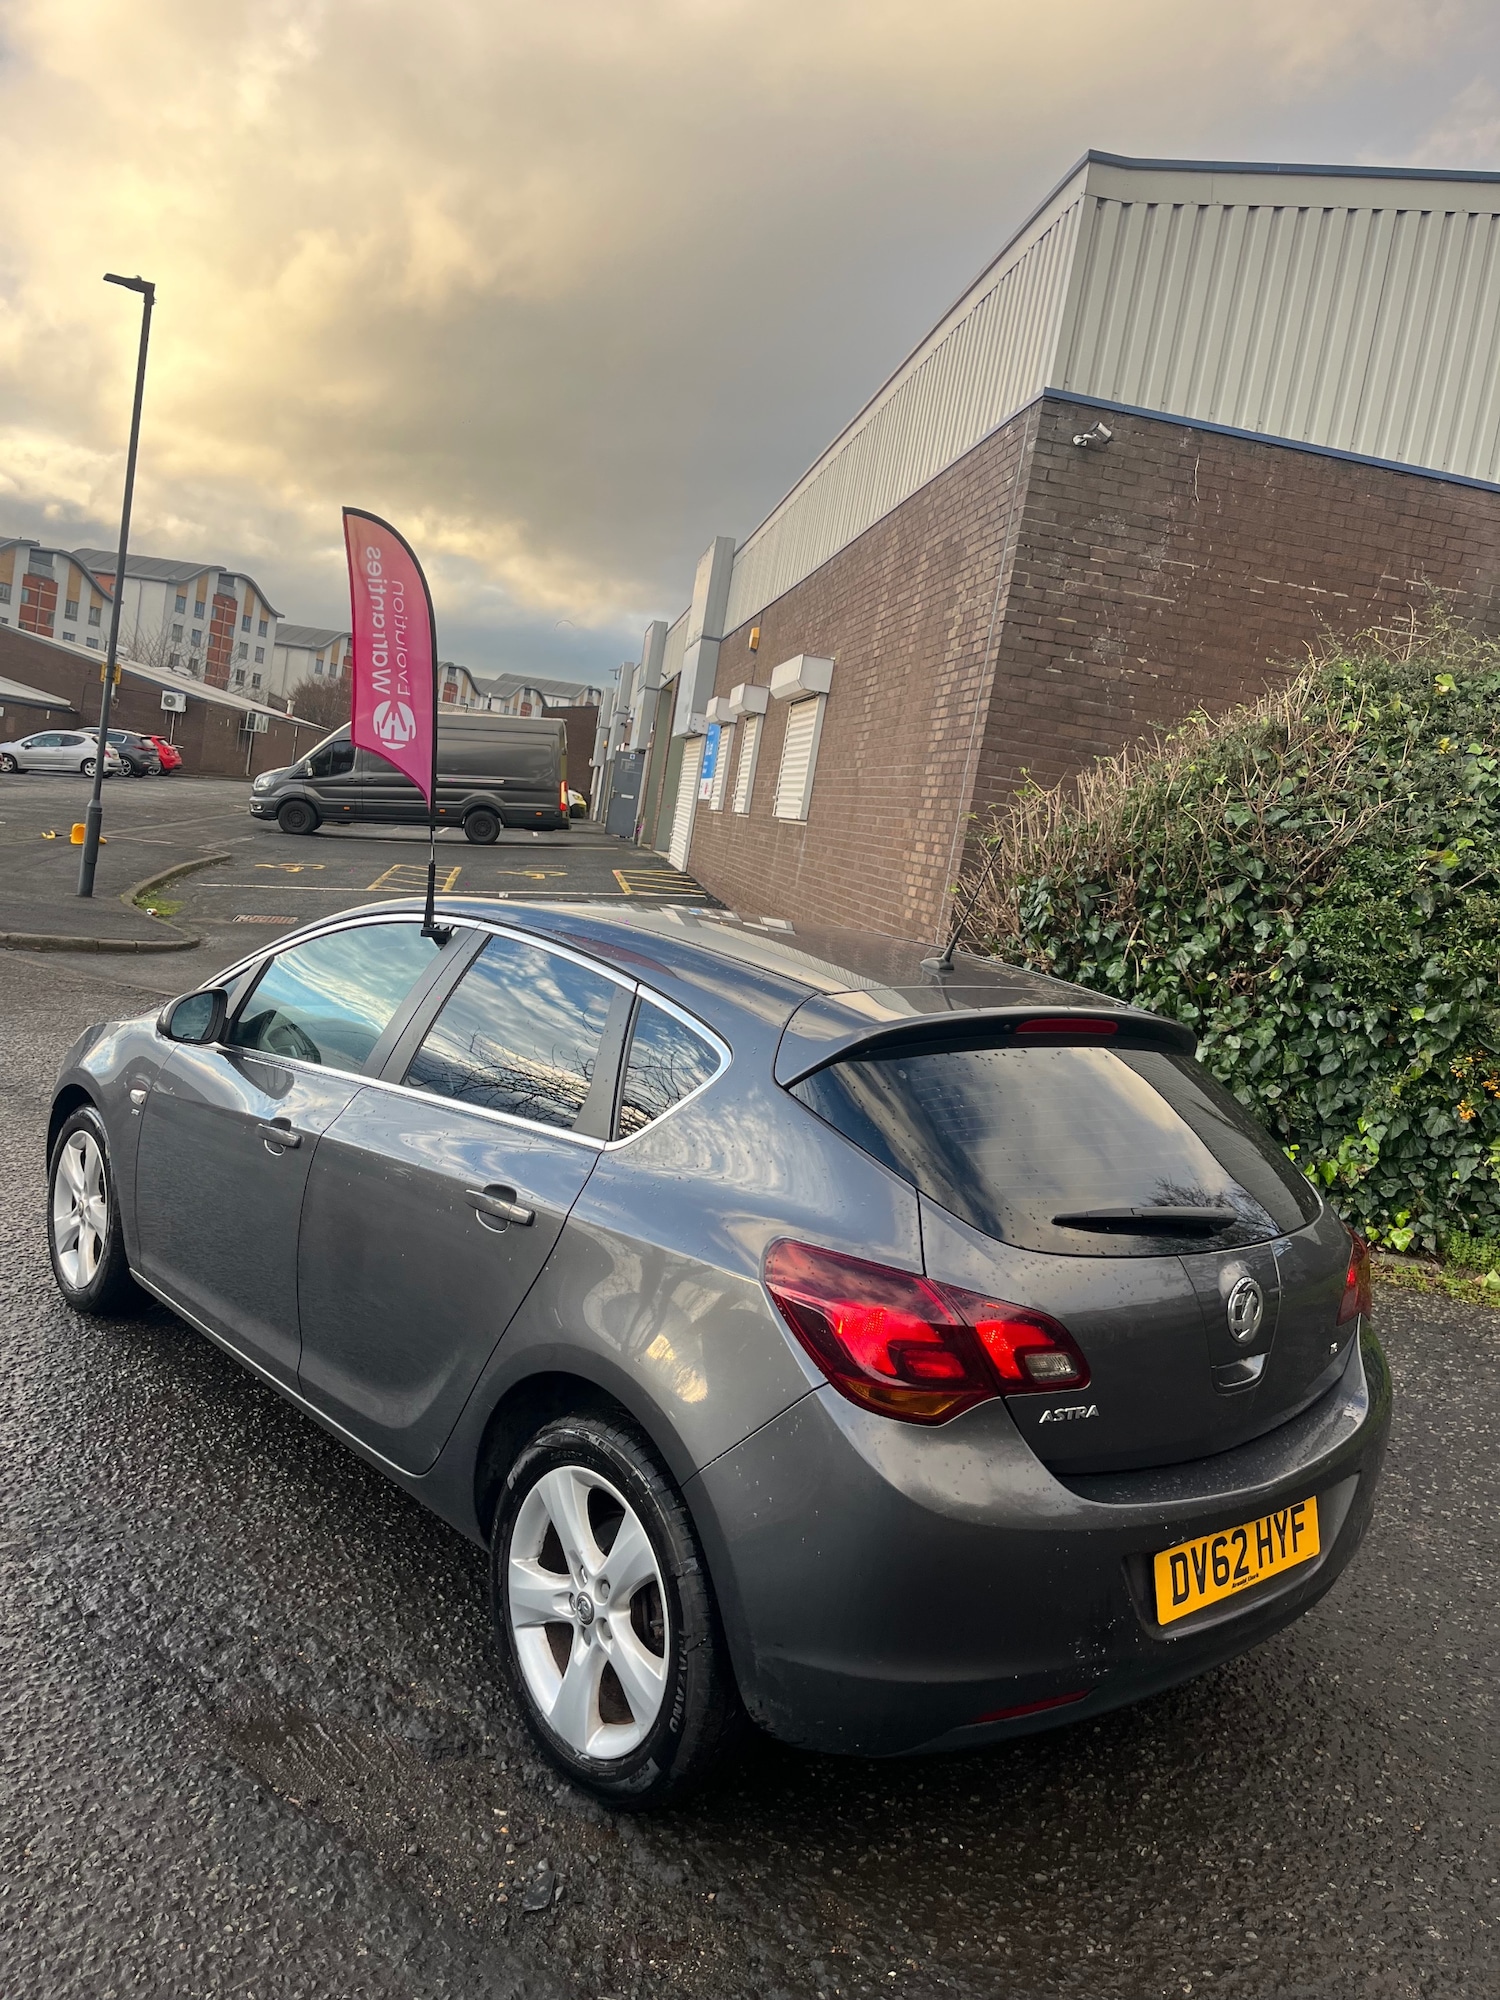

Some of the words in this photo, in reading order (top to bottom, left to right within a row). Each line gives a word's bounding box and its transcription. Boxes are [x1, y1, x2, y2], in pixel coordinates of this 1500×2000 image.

[1038, 1404, 1100, 1424] ASTRA
[1169, 1528, 1250, 1607] DV62
[1255, 1503, 1305, 1569] HYF
